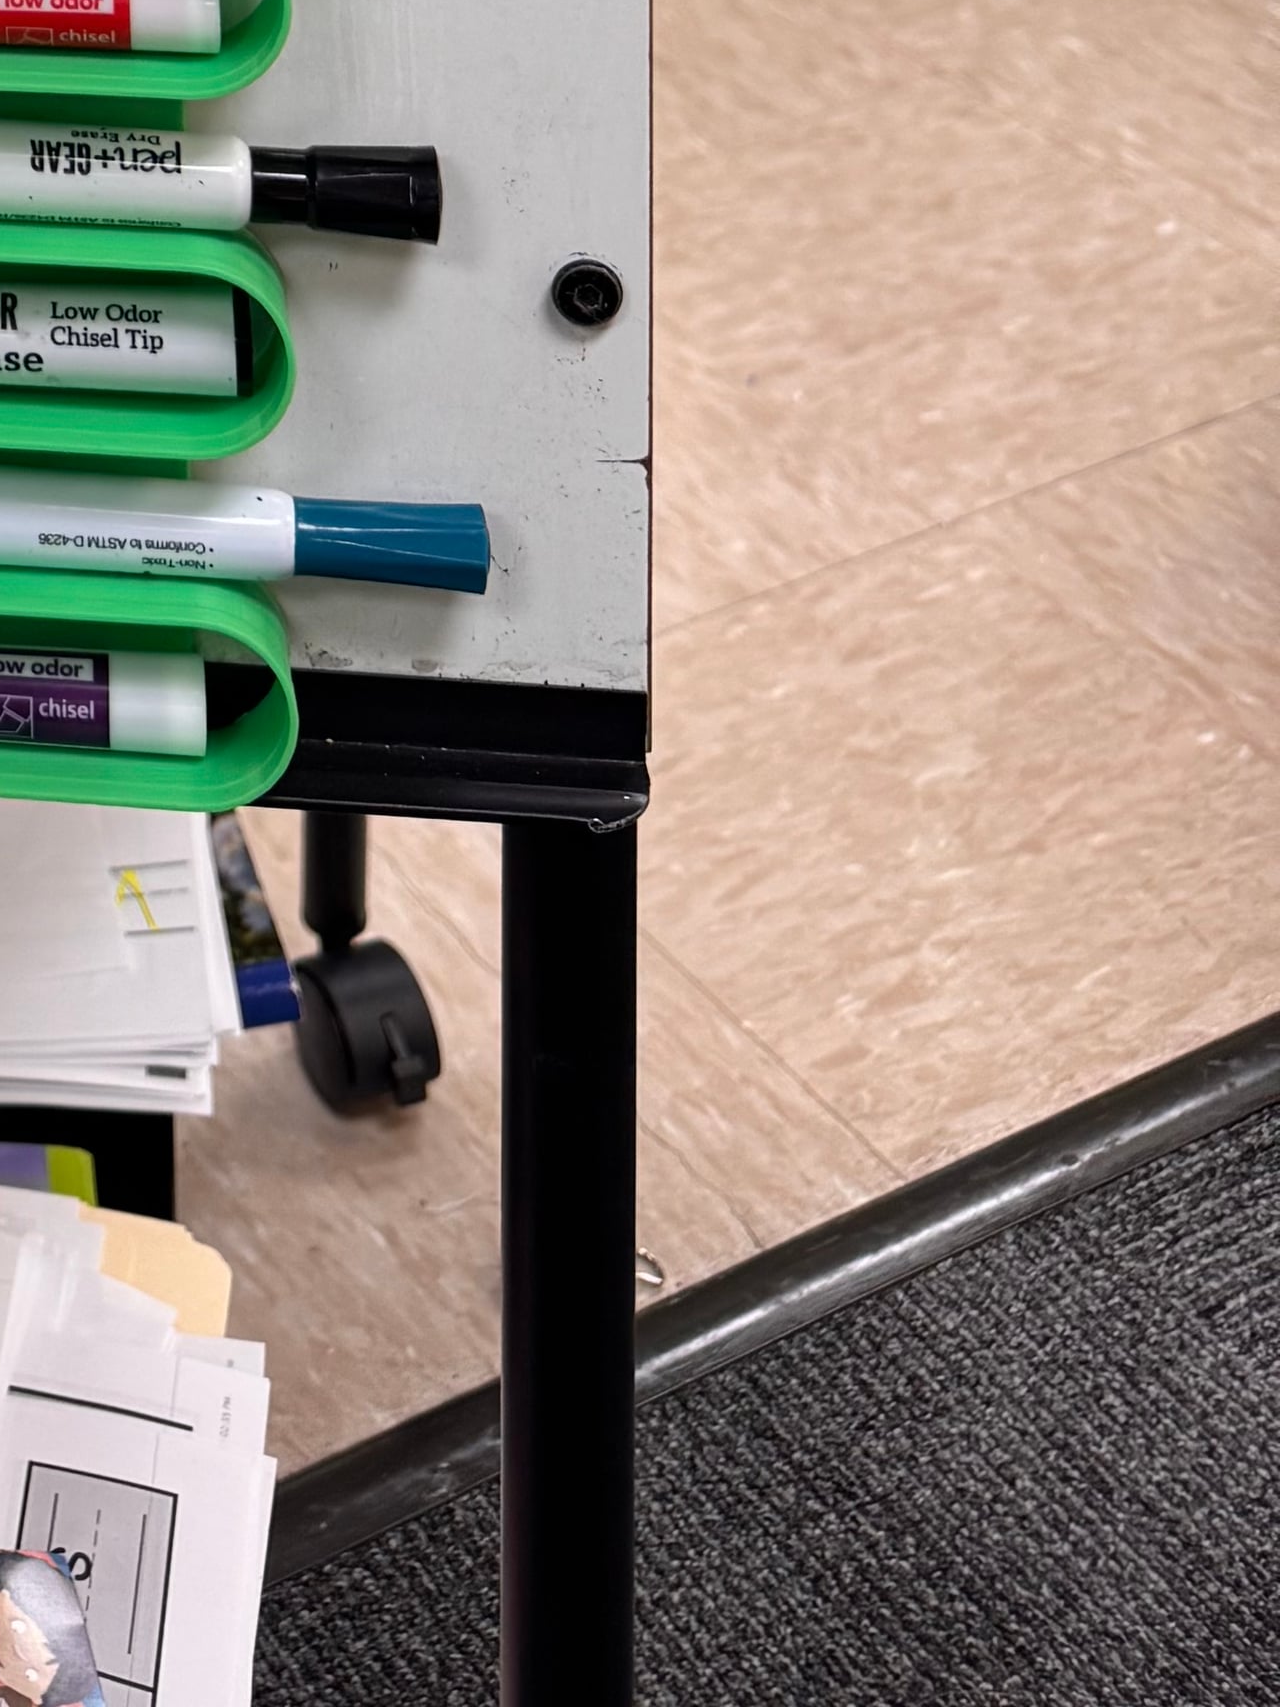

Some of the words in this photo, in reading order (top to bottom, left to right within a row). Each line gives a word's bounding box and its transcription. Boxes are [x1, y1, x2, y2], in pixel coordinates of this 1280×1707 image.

[59, 28, 116, 43] chisel
[71, 129, 120, 144] Erase
[126, 133, 161, 146] Dry
[31, 139, 182, 175] pen+GEAR
[51, 301, 96, 321] Low
[105, 304, 162, 324] Odor
[50, 326, 119, 349] Chisel
[125, 329, 165, 353] Tip
[39, 532, 84, 548] D-4236
[87, 536, 127, 551] ASTM
[130, 540, 142, 549] to
[145, 541, 207, 555] Conforms
[32, 657, 84, 678] odor
[39, 698, 94, 720] chisel
